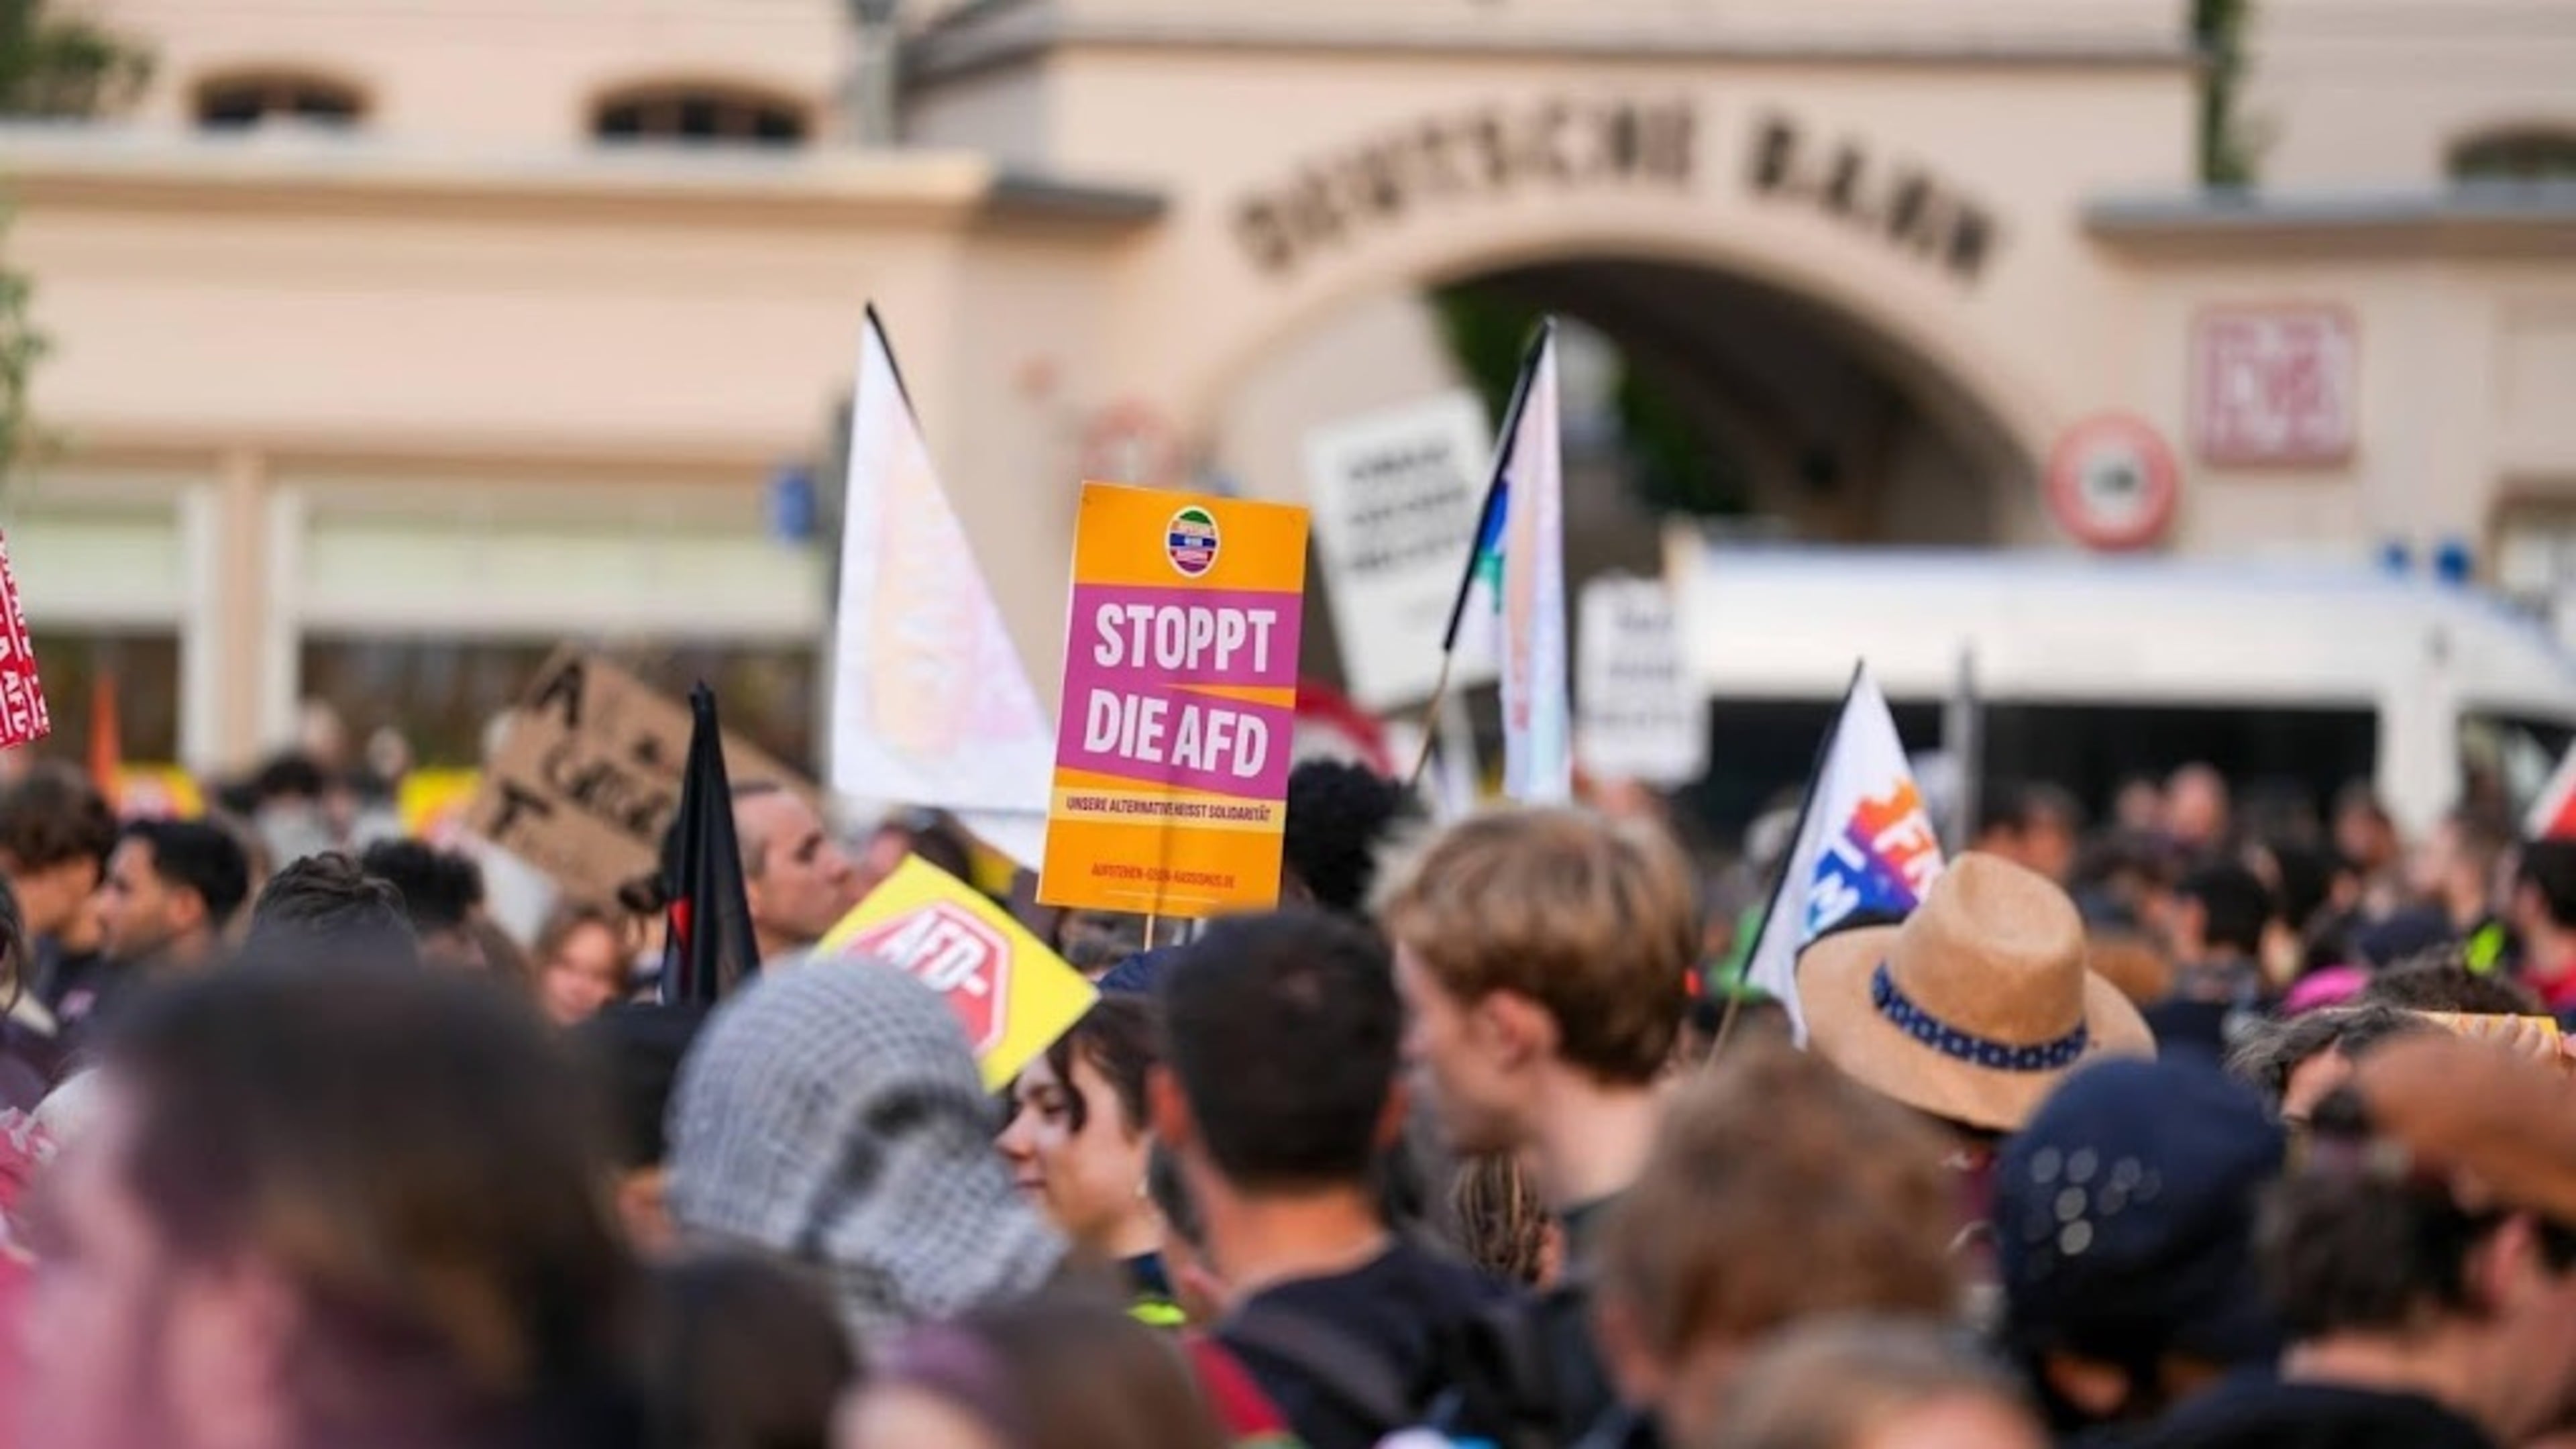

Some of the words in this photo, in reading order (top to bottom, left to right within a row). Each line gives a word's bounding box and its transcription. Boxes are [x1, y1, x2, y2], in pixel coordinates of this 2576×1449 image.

[1093, 603, 1277, 673] STOPPT
[1083, 688, 1169, 763] DIE
[1172, 705, 1269, 779] AFD
[1066, 796, 1109, 812] UNSERE
